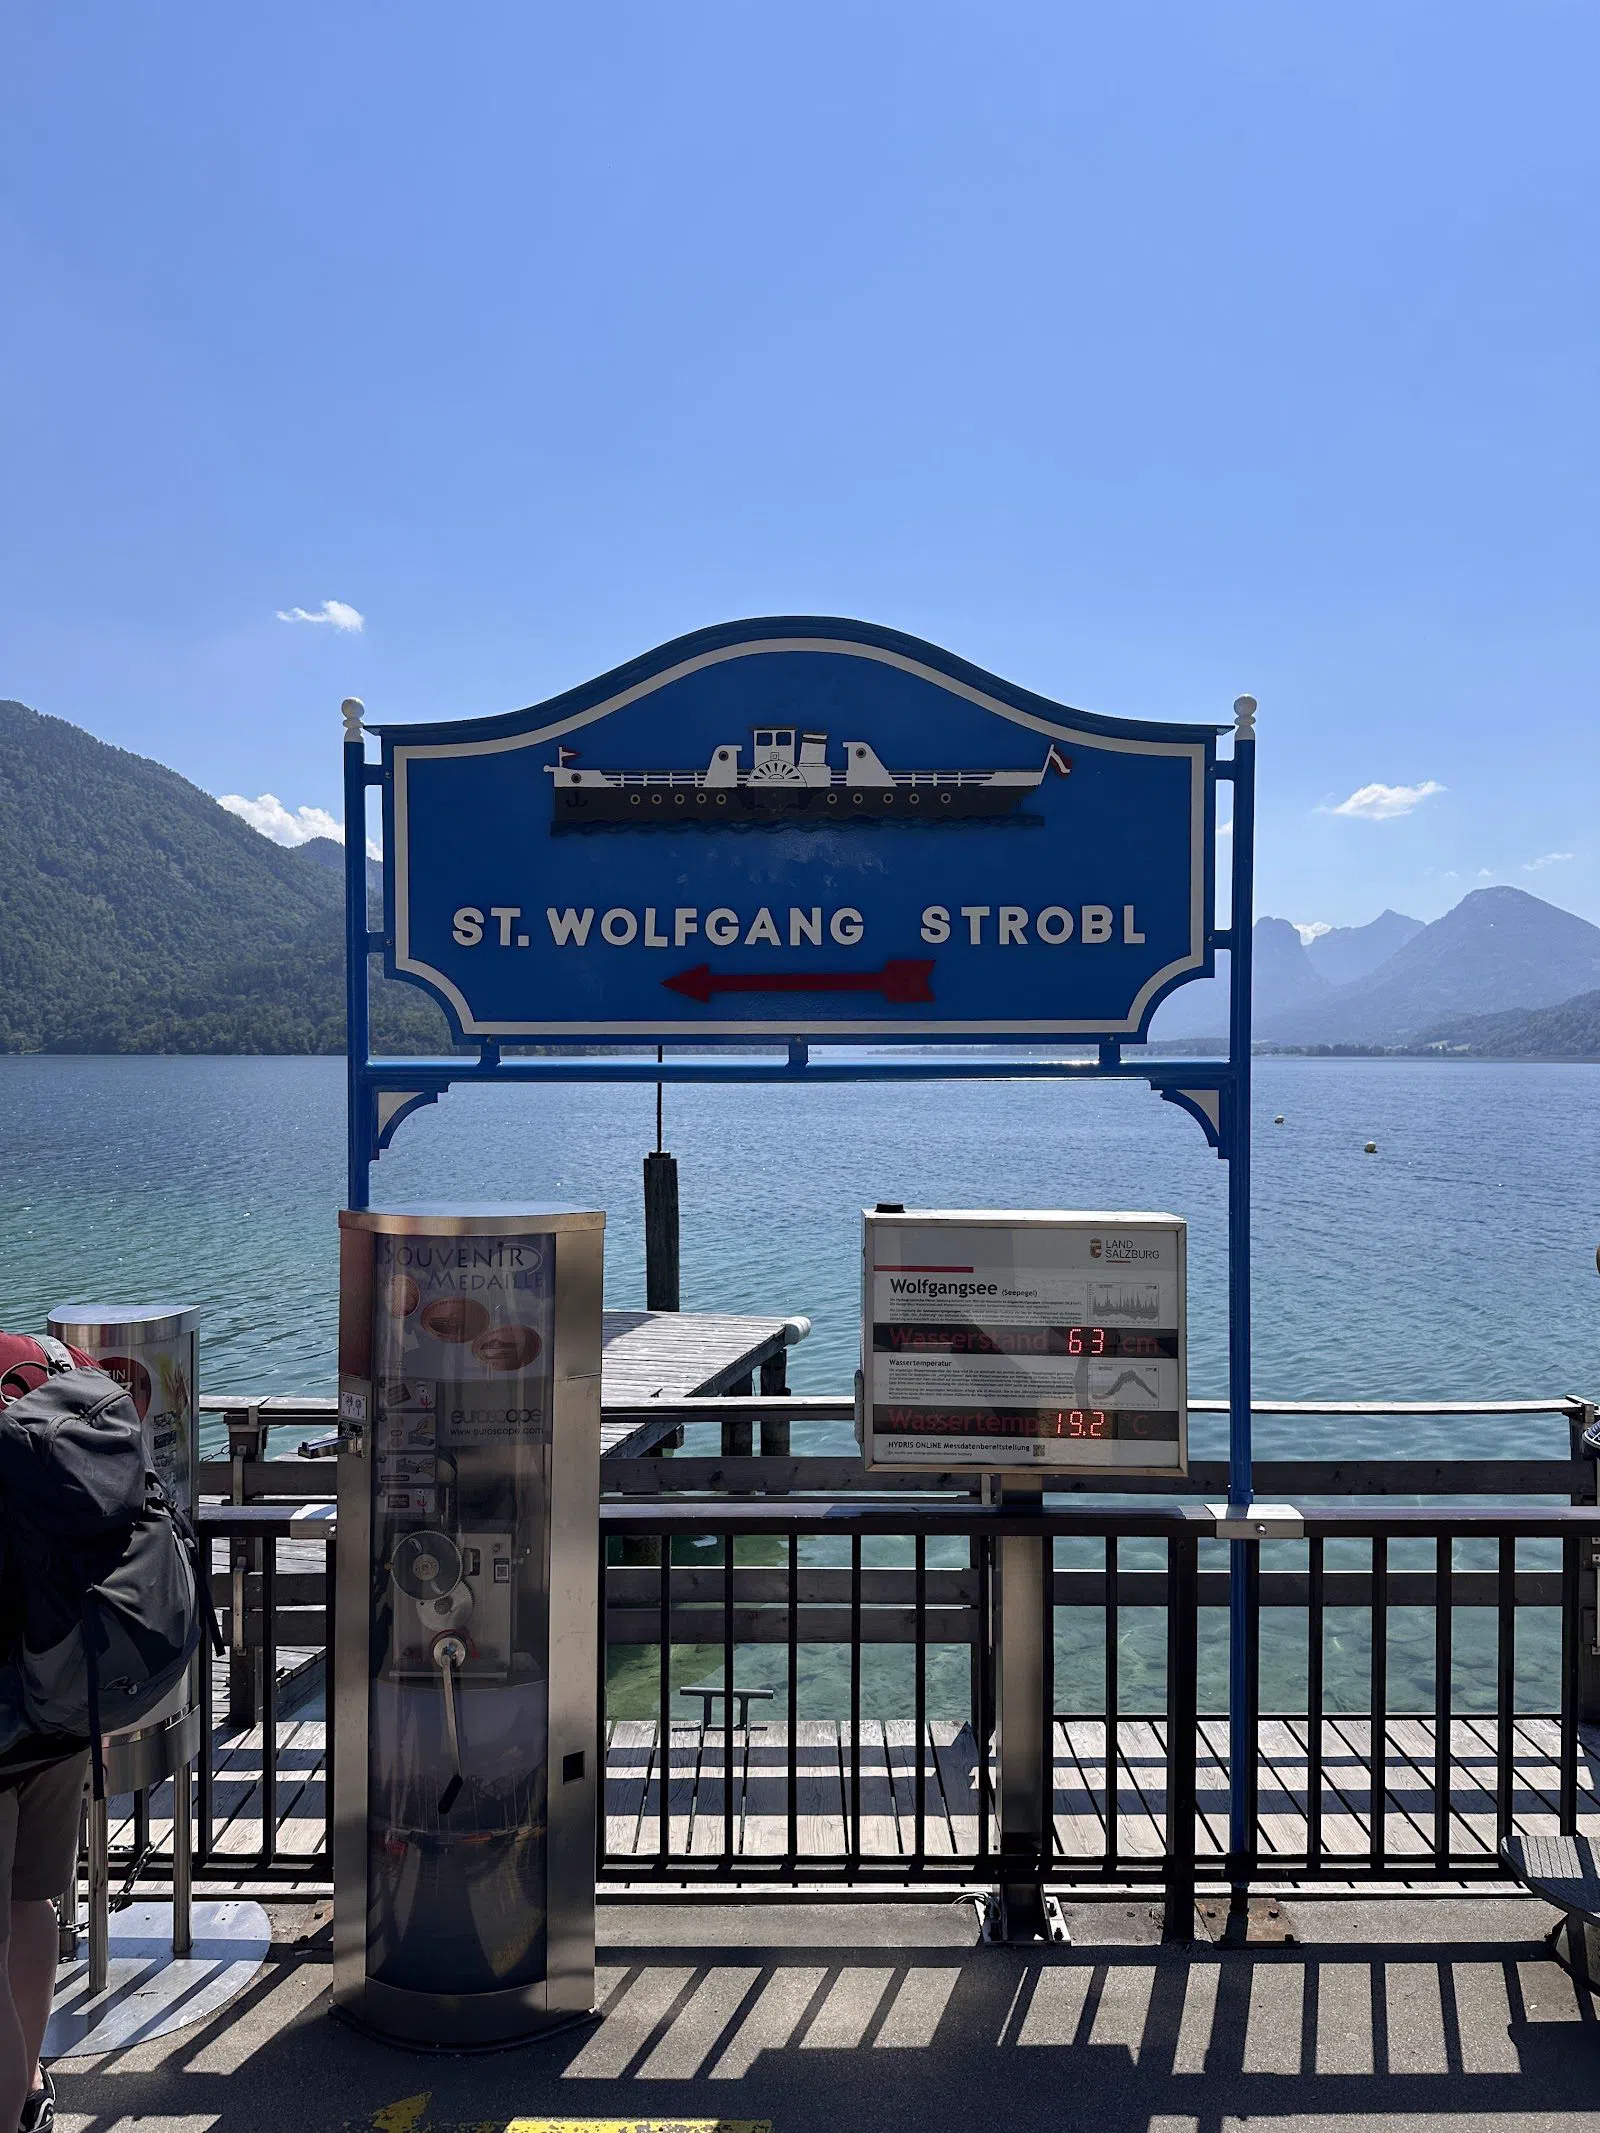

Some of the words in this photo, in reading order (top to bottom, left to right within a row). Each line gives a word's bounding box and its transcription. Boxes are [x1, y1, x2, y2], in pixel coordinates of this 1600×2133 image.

[452, 907, 530, 947] ST.
[546, 907, 864, 948] WOLFGANG
[920, 905, 1146, 946] STROBL
[1105, 1239, 1134, 1249] LAND
[1105, 1249, 1160, 1260] SALZBURG
[427, 1269, 544, 1292] MEDAILLE
[890, 1278, 998, 1298] Wolfgangsee
[889, 1327, 1049, 1351] Wasserstand
[1068, 1328, 1105, 1354] 63
[1122, 1335, 1160, 1353] cm
[888, 1358, 953, 1368] Wassertemperatur
[1056, 1411, 1105, 1437] 19.2
[887, 1441, 914, 1449] HYDRIS
[915, 1441, 942, 1450] ONLINE
